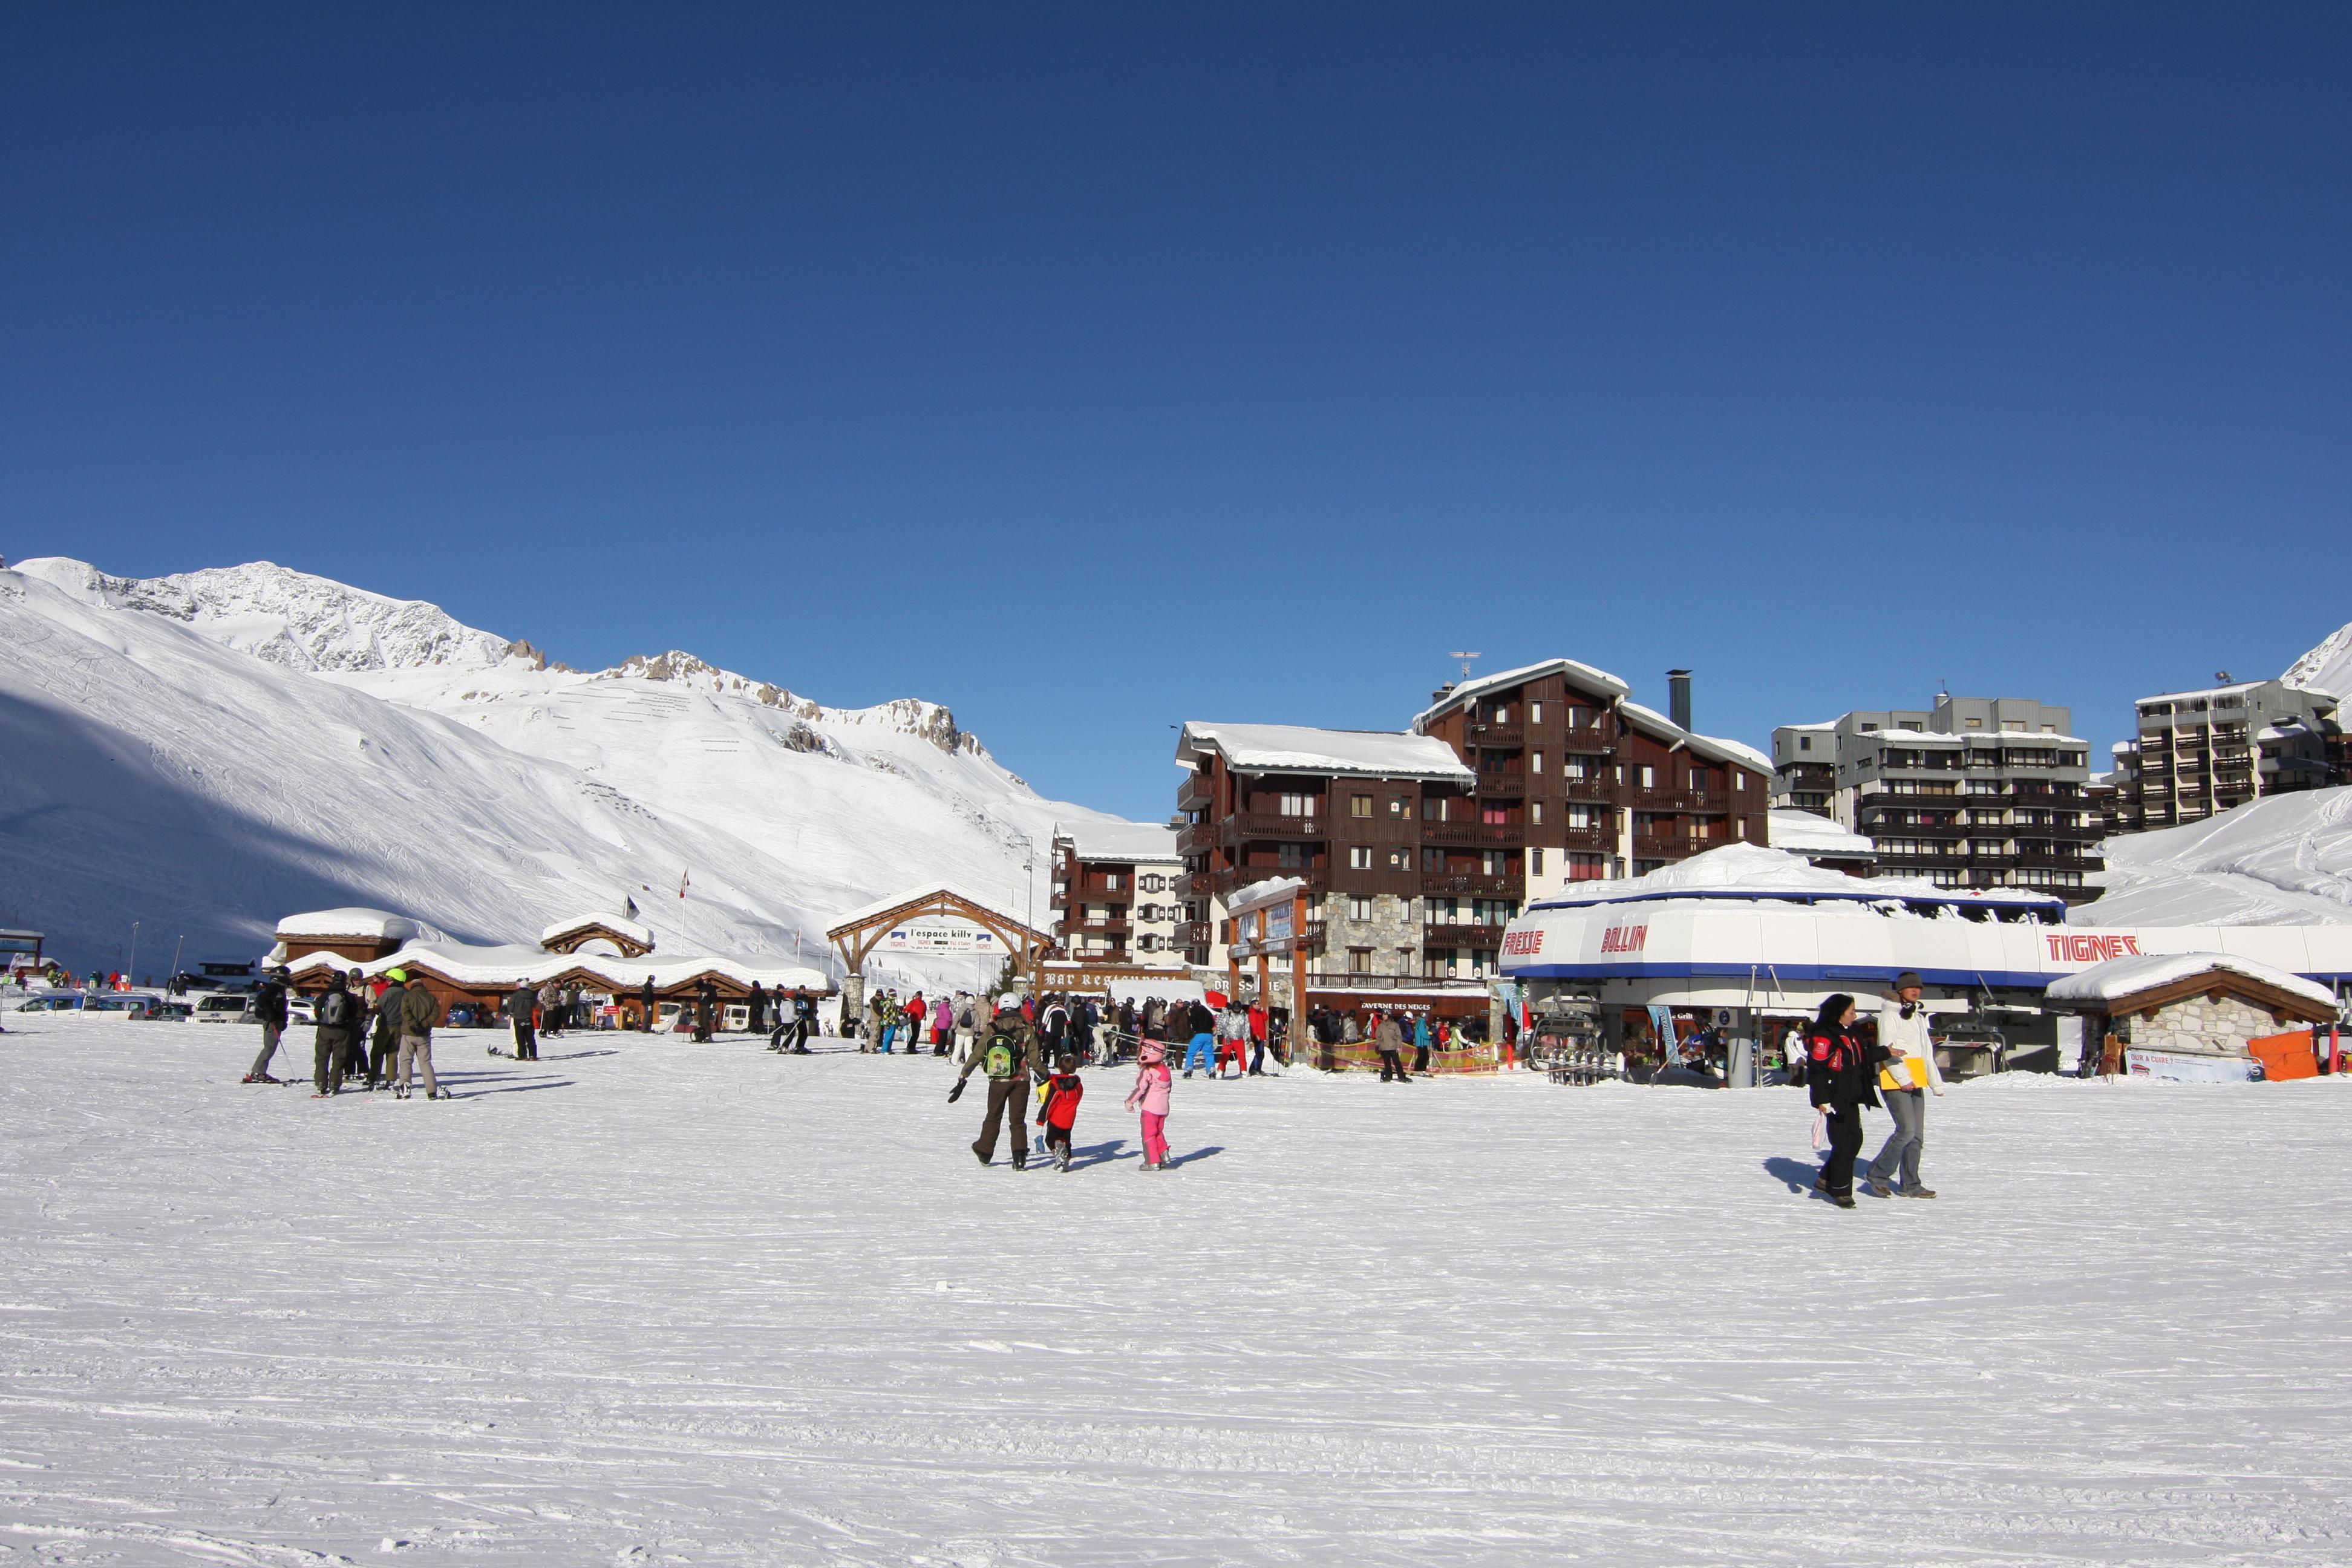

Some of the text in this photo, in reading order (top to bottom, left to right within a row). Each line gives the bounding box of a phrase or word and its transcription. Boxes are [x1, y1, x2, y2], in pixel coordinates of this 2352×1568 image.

[911, 929, 948, 939] l'espace
[1601, 925, 1648, 953] BOLLIN
[1501, 930, 1544, 955] FRESSE
[2046, 935, 2141, 961] TIGNES
[1044, 973, 1076, 985] Bar
[1214, 980, 1279, 991] BRSSIE
[2151, 1056, 2169, 1064] CUIRE
